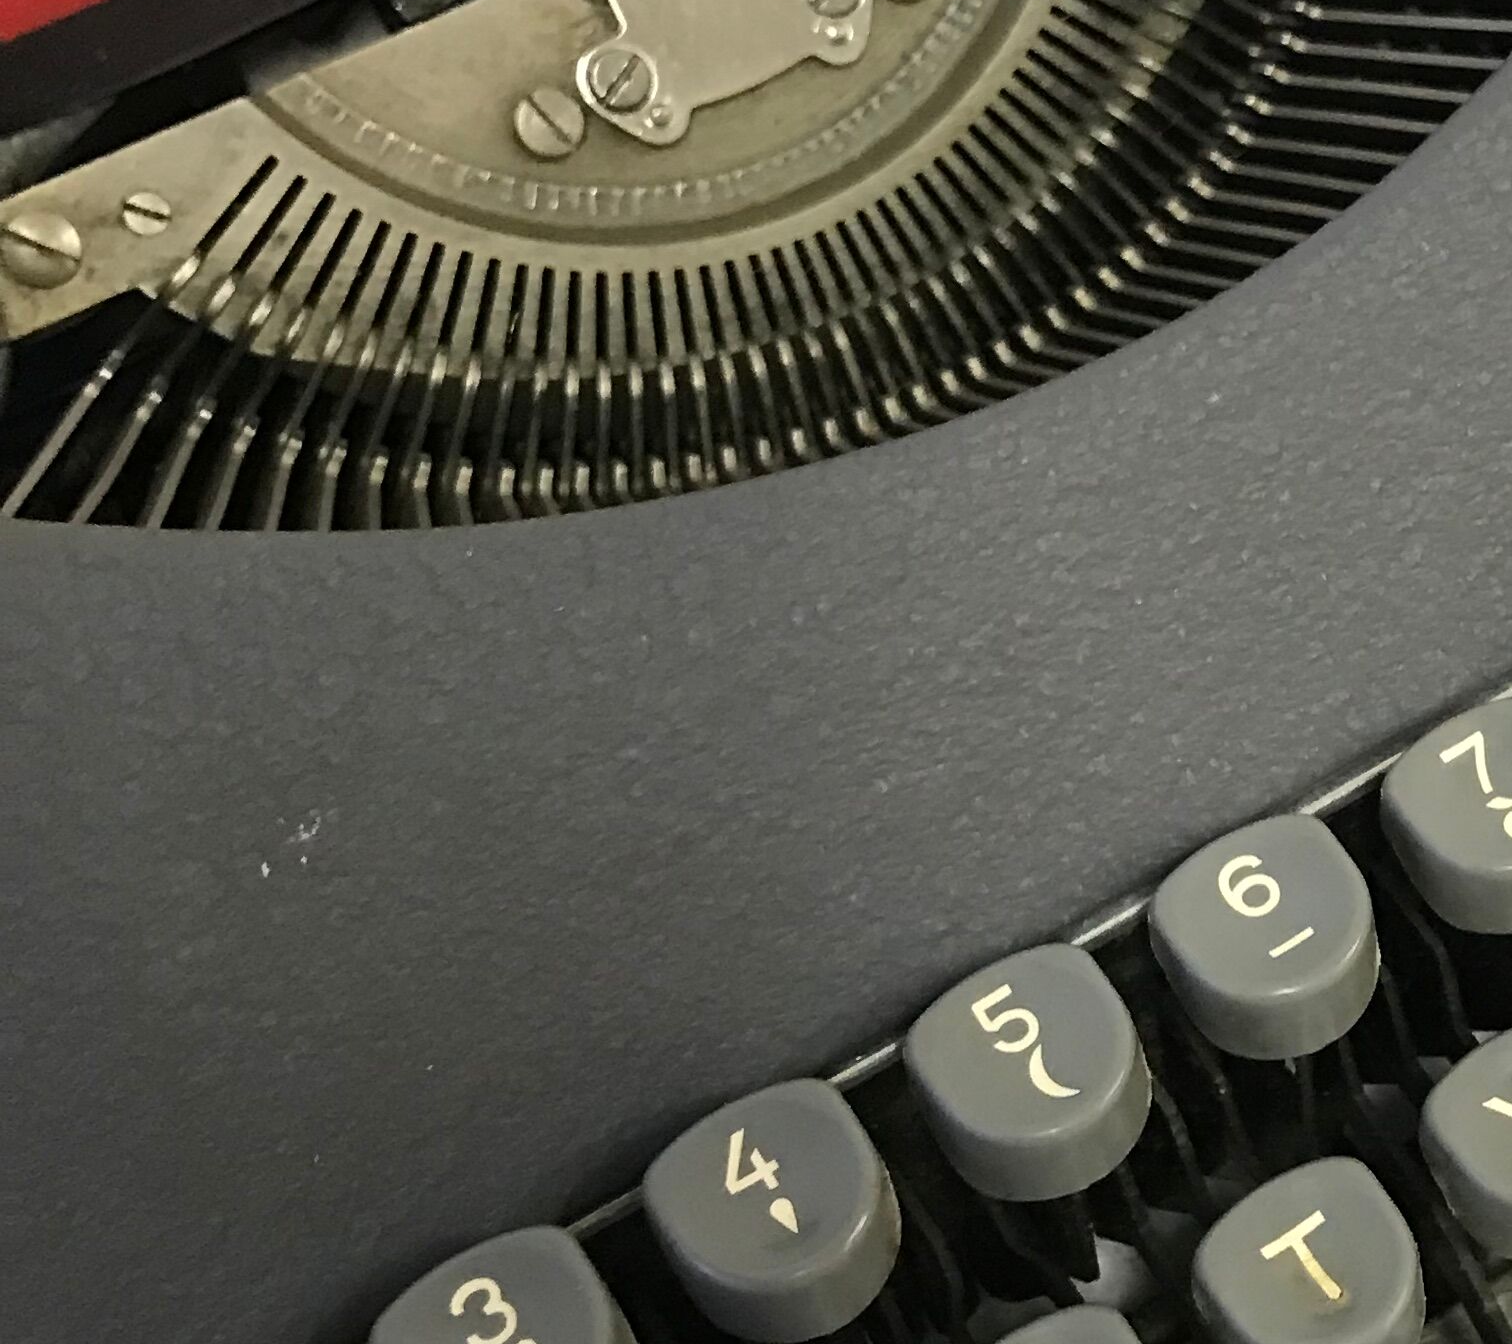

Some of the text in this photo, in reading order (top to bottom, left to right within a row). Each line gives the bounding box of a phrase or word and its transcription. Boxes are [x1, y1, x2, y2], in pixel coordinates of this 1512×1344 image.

[1439, 730, 1494, 794] 7
[1218, 854, 1281, 917] 6
[971, 983, 1040, 1054] 5
[725, 1127, 779, 1195] 4
[1259, 1210, 1342, 1300] T
